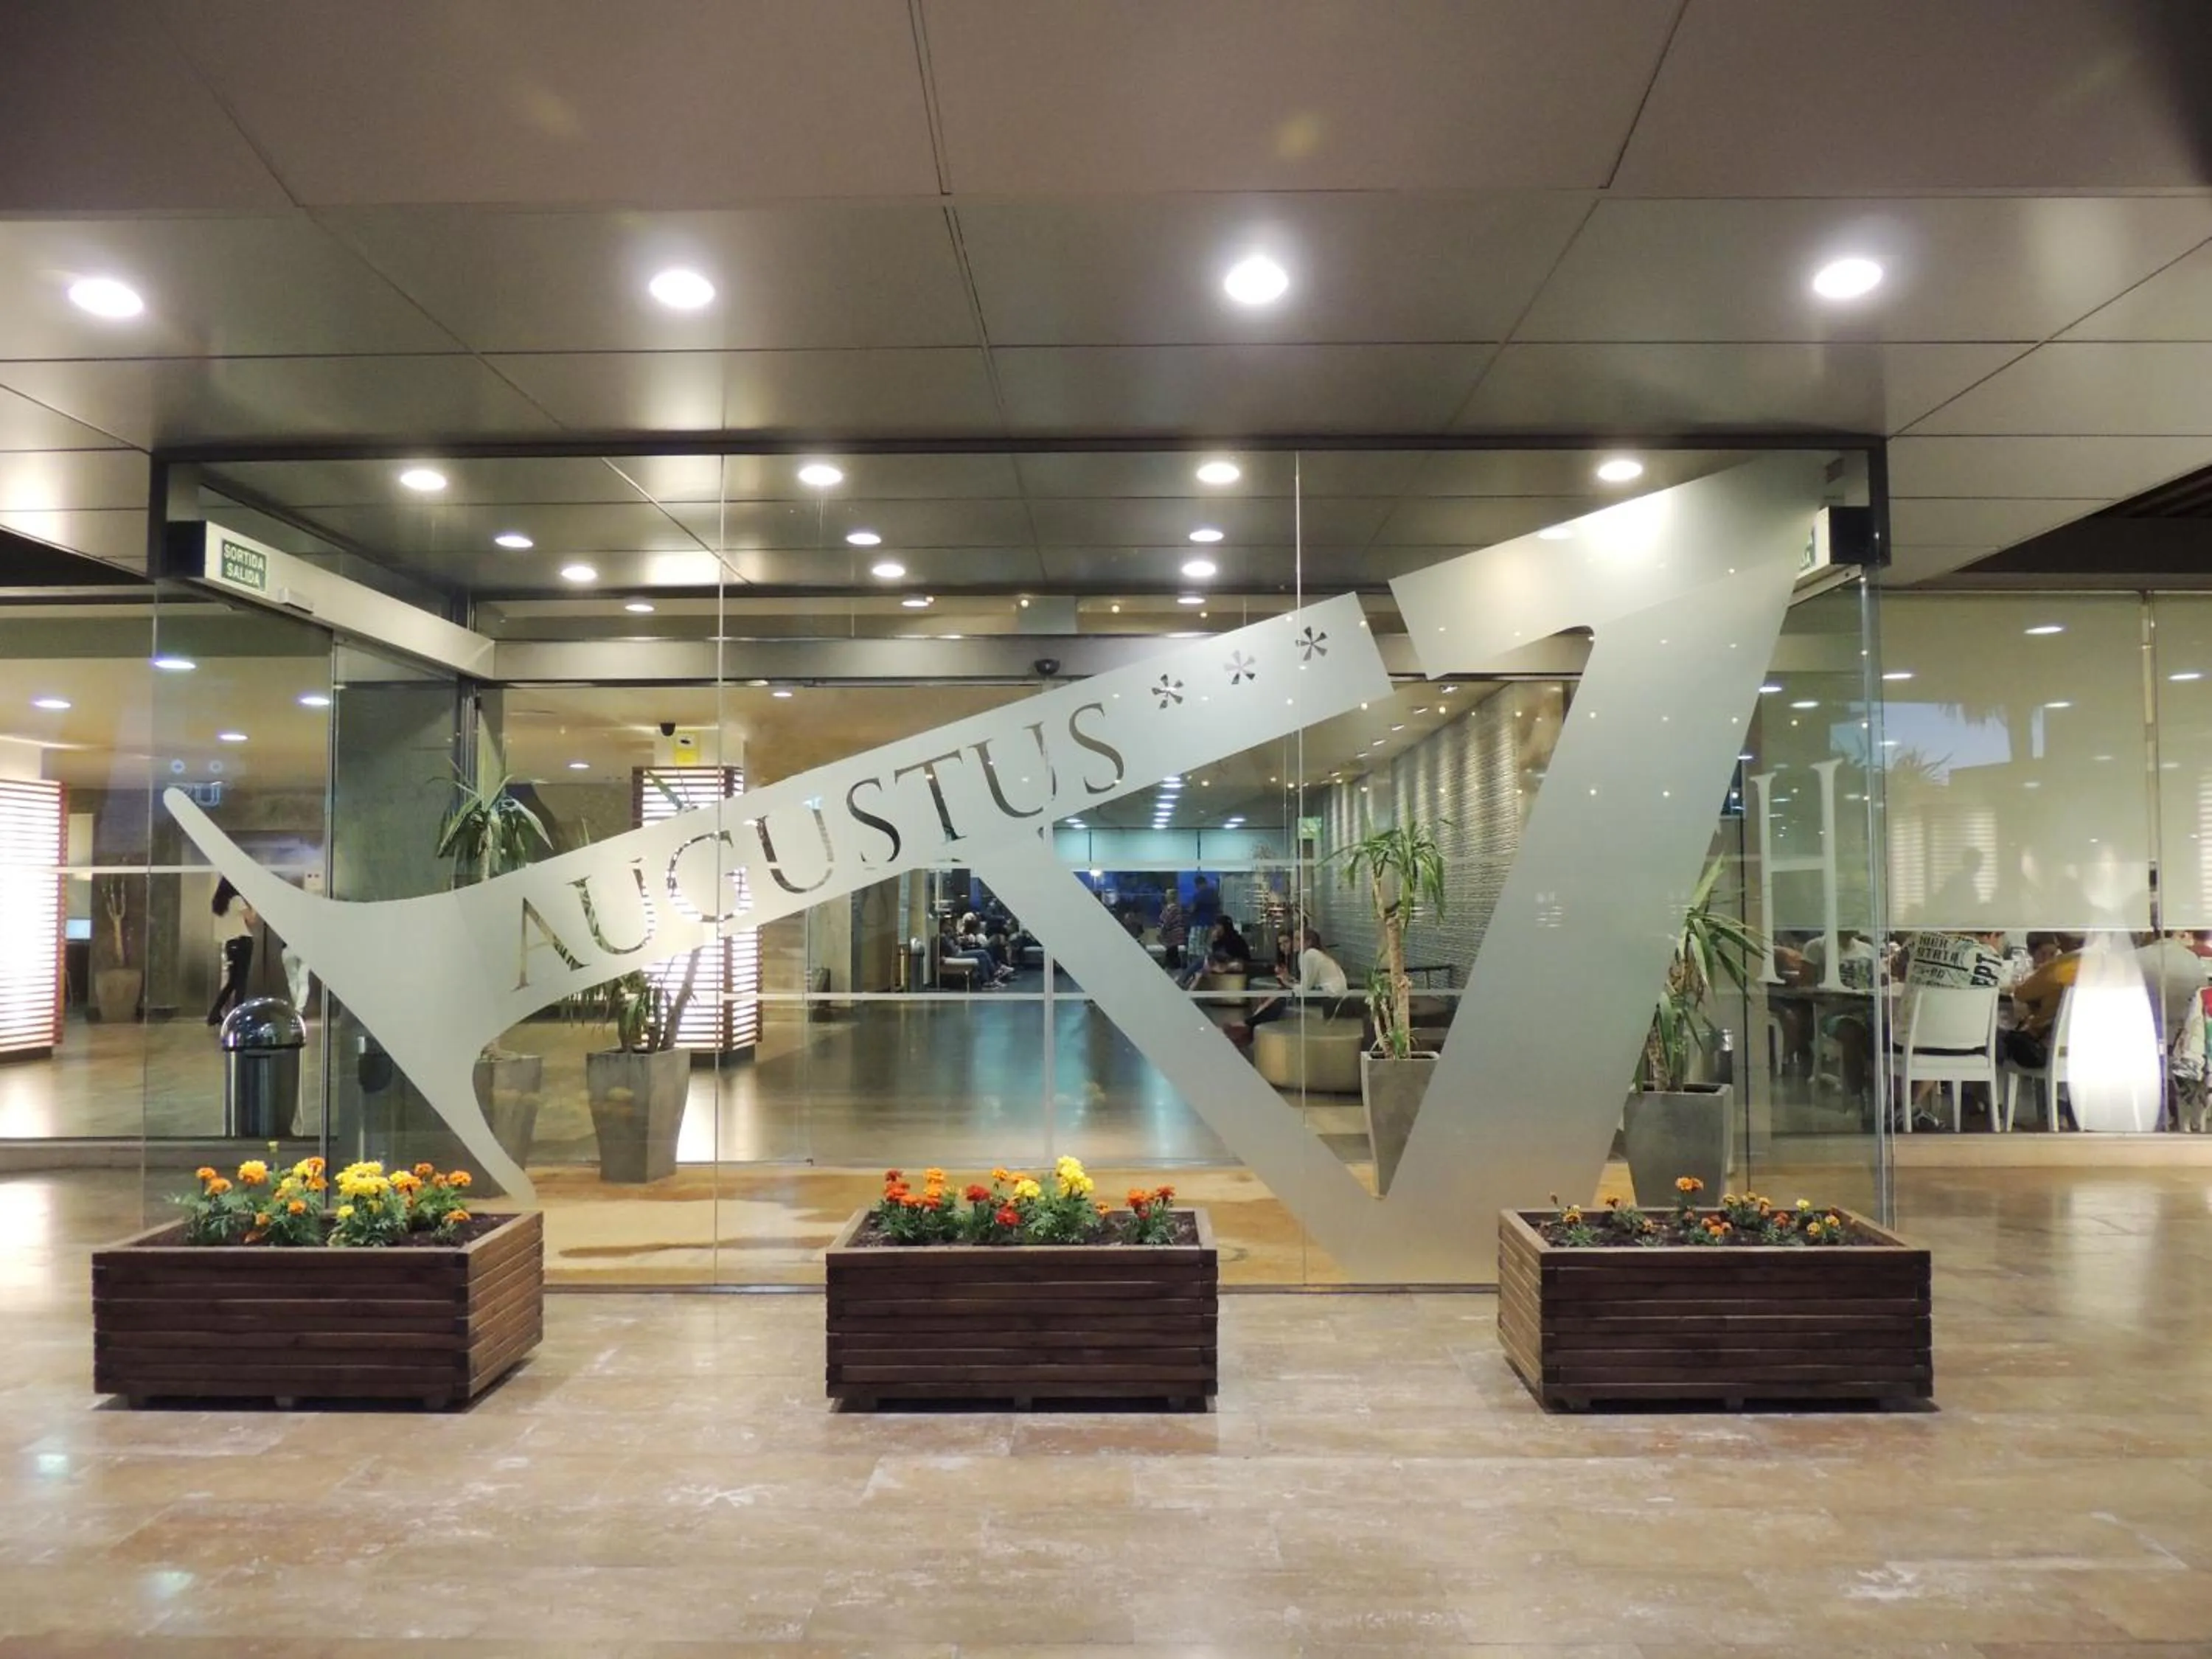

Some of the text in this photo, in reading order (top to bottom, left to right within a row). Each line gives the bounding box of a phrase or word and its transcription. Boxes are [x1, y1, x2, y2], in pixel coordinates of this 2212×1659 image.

[223, 543, 264, 571] SORTIDA
[226, 562, 260, 585] SALIDA
[512, 702, 1125, 992] AUGUSTUS
